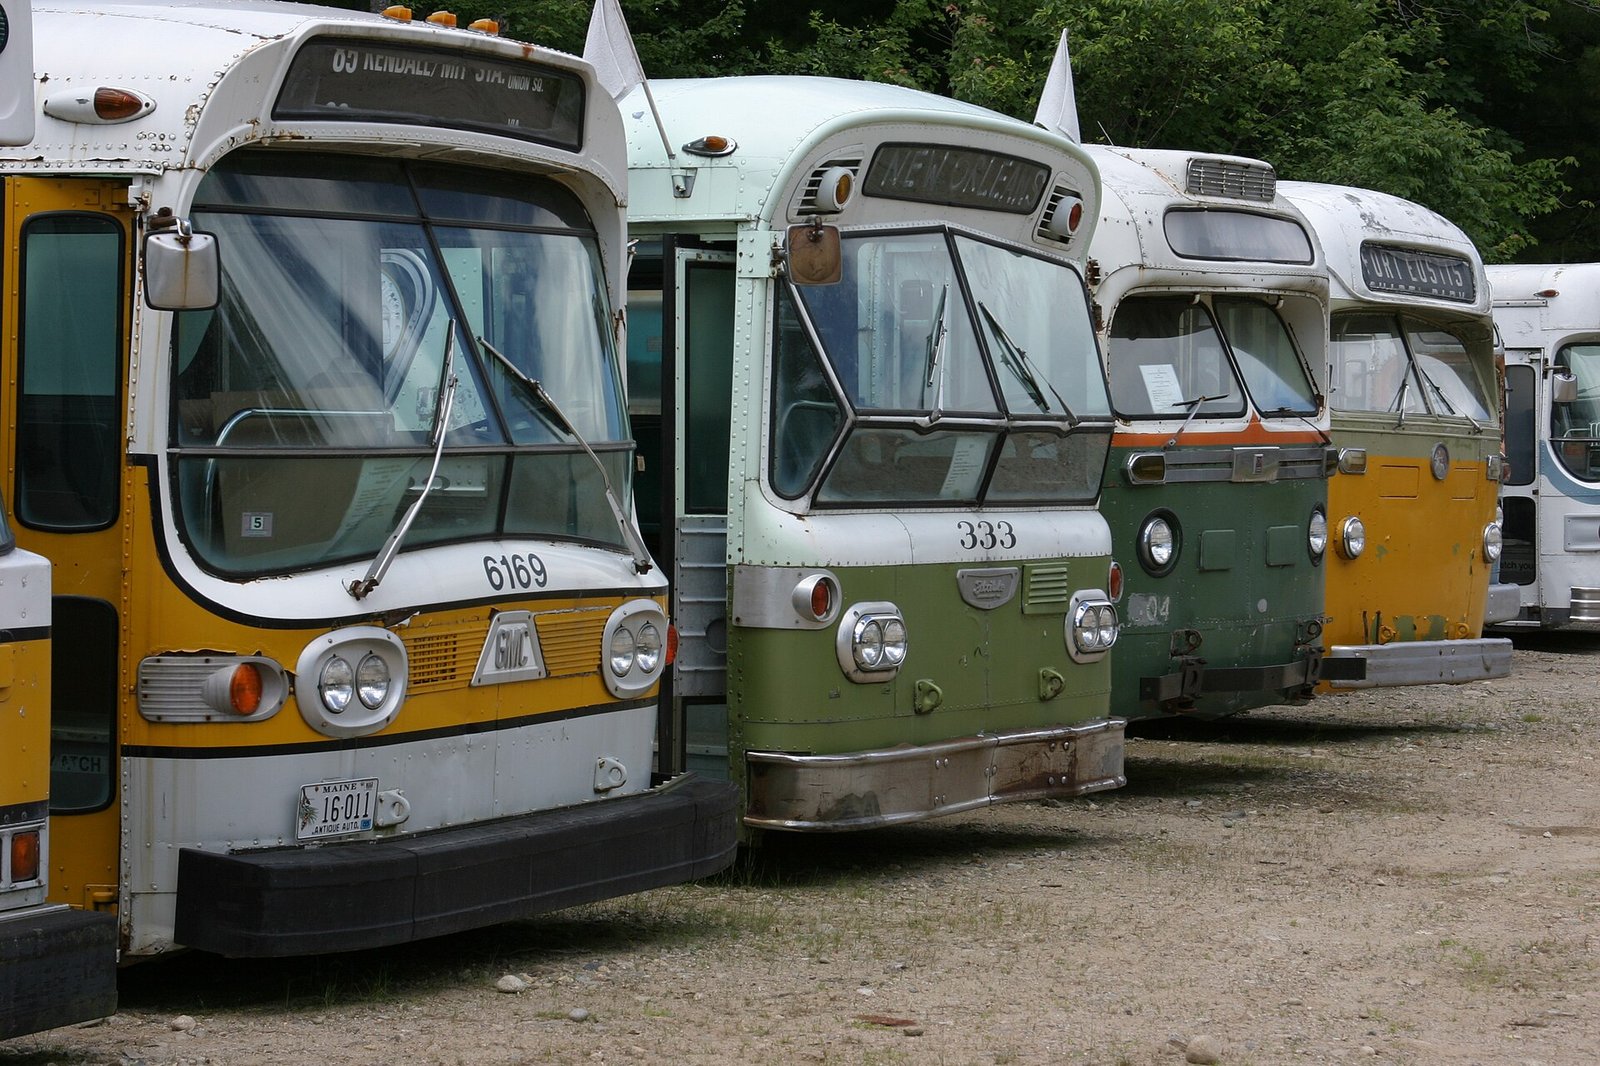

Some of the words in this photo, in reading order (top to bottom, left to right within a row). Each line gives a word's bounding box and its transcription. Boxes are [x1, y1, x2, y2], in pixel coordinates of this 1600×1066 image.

[881, 150, 950, 189] NEW
[254, 517, 262, 529] 5
[957, 520, 1017, 550] 333
[483, 553, 548, 591] 6169
[494, 628, 529, 670] GMC
[322, 782, 358, 794] MAINE
[314, 823, 341, 834] ANTIQUE
